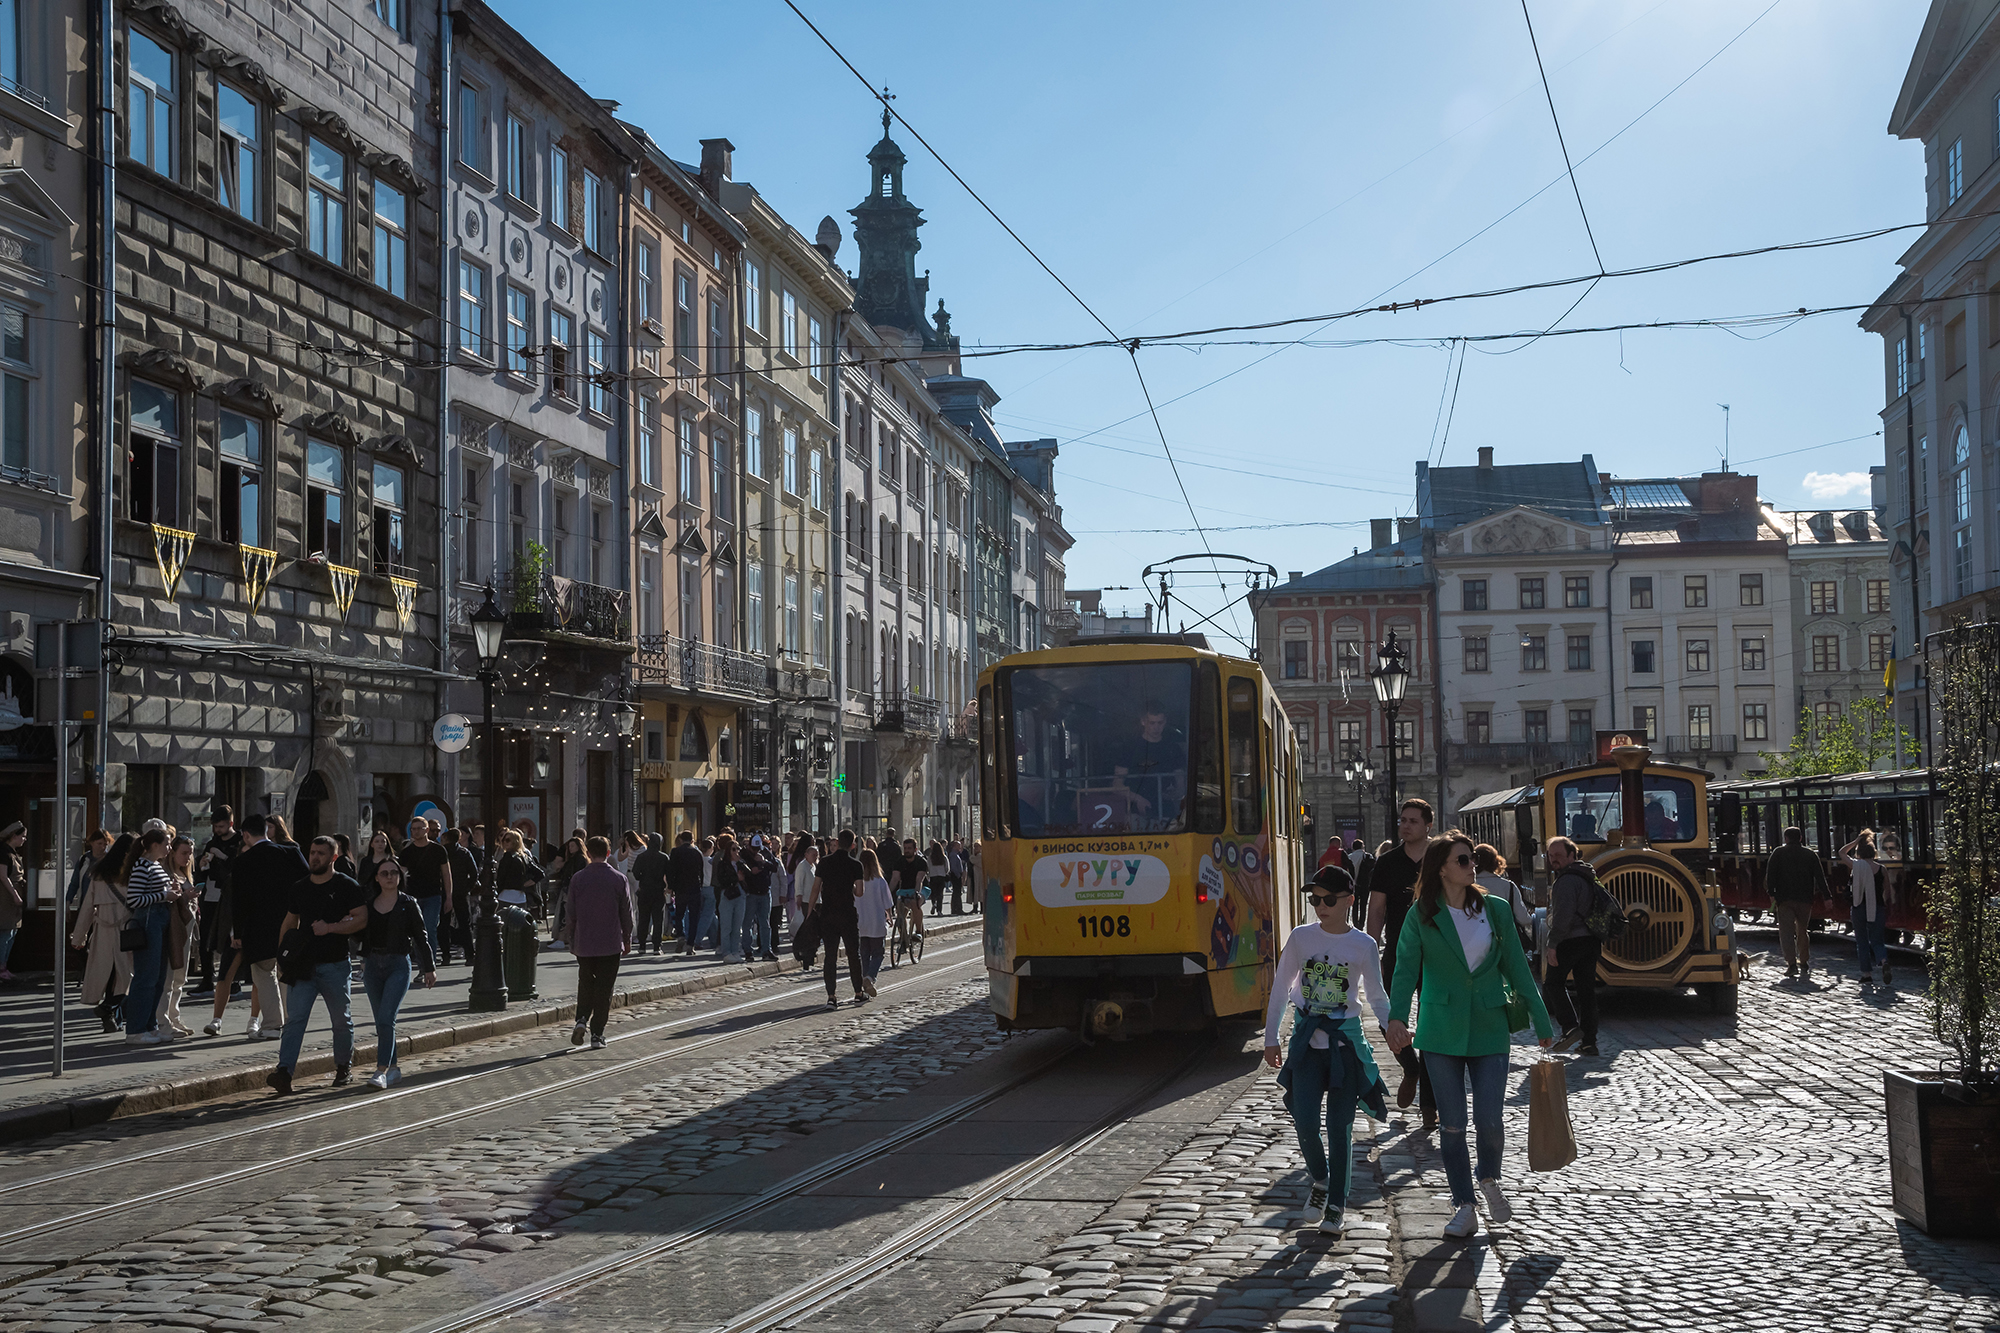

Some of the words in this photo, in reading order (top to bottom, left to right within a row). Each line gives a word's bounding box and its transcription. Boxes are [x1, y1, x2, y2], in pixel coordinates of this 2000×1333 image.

[1092, 803, 1113, 829] 2
[1042, 843, 1084, 854] ВИНОС
[1088, 841, 1136, 852] КУЗОВА
[1058, 859, 1142, 888] УРУРУ
[1077, 915, 1131, 938] 1108
[1303, 961, 1349, 978] LOVE
[1307, 974, 1343, 991] THE
